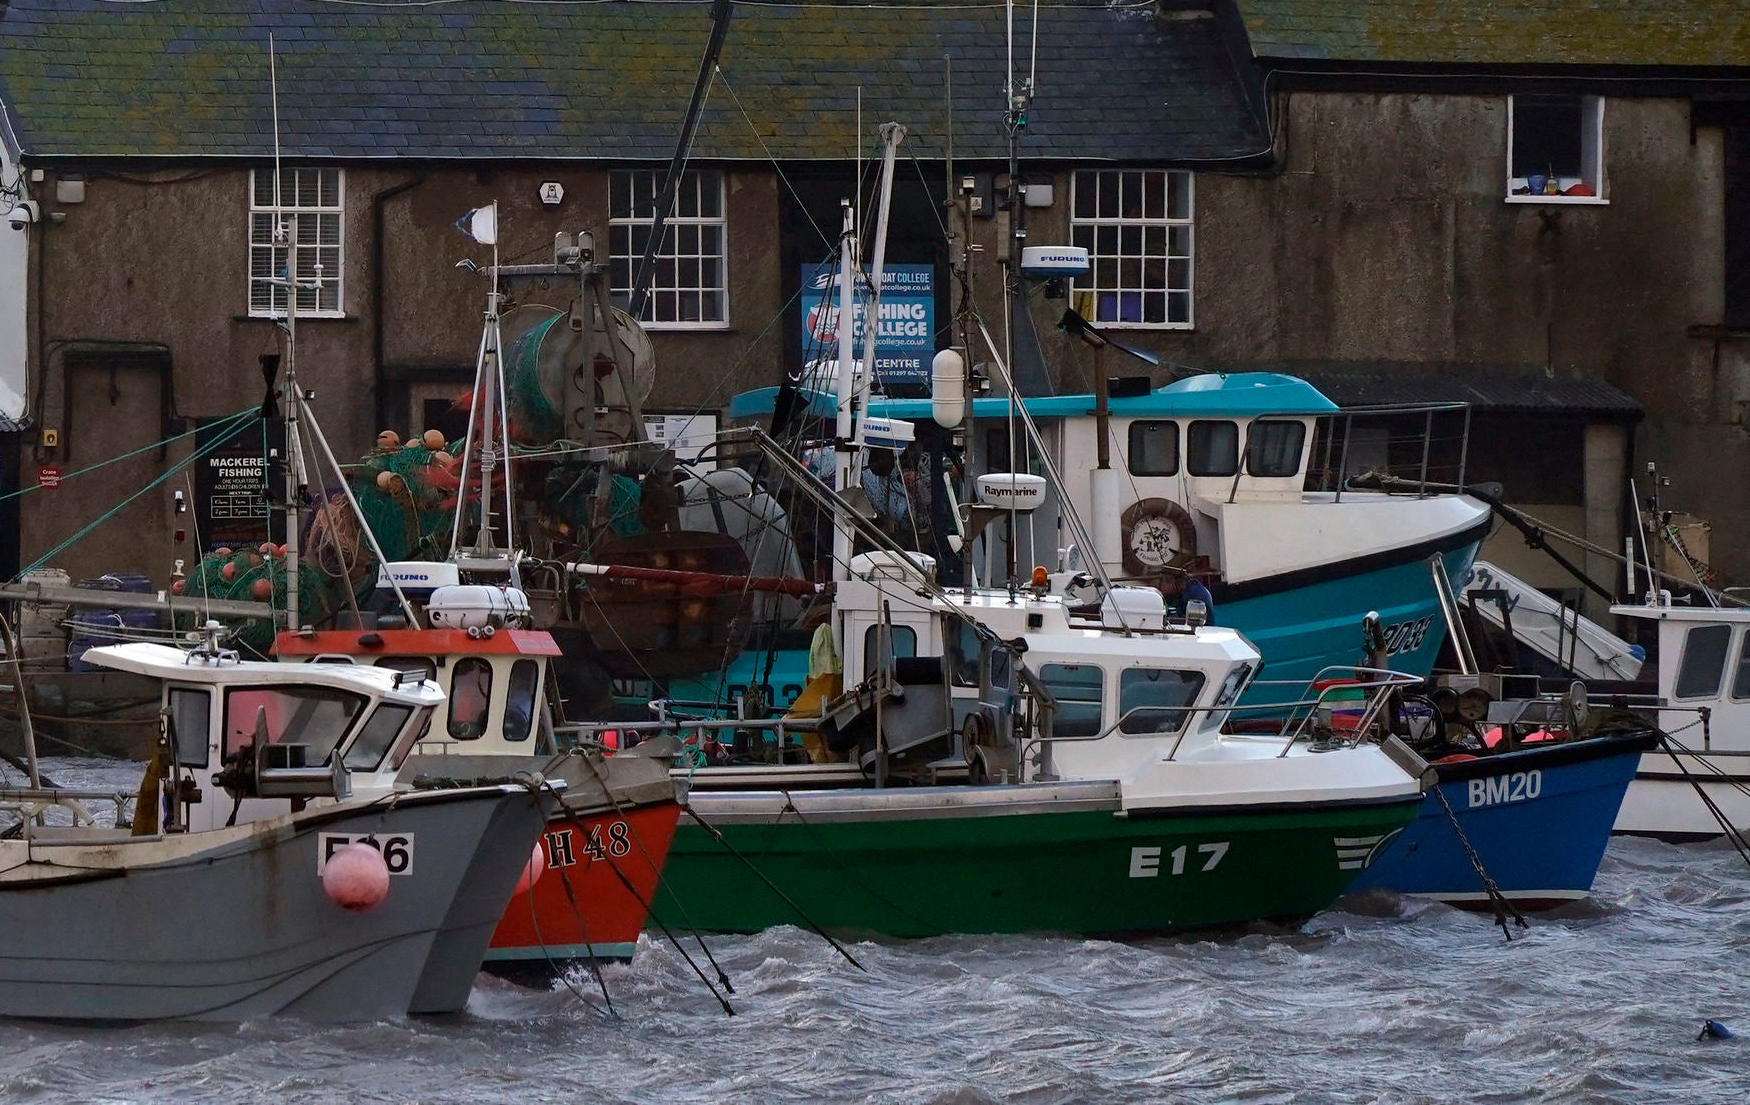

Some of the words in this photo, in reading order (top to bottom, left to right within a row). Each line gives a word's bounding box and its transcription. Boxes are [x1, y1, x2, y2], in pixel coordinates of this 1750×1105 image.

[897, 273, 930, 283] COLLEGE
[876, 359, 920, 368] CENTRE
[219, 468, 262, 477] FISHING
[984, 485, 1037, 497] Raymarine
[1468, 769, 1542, 808] BM20
[1129, 841, 1230, 878] E17
